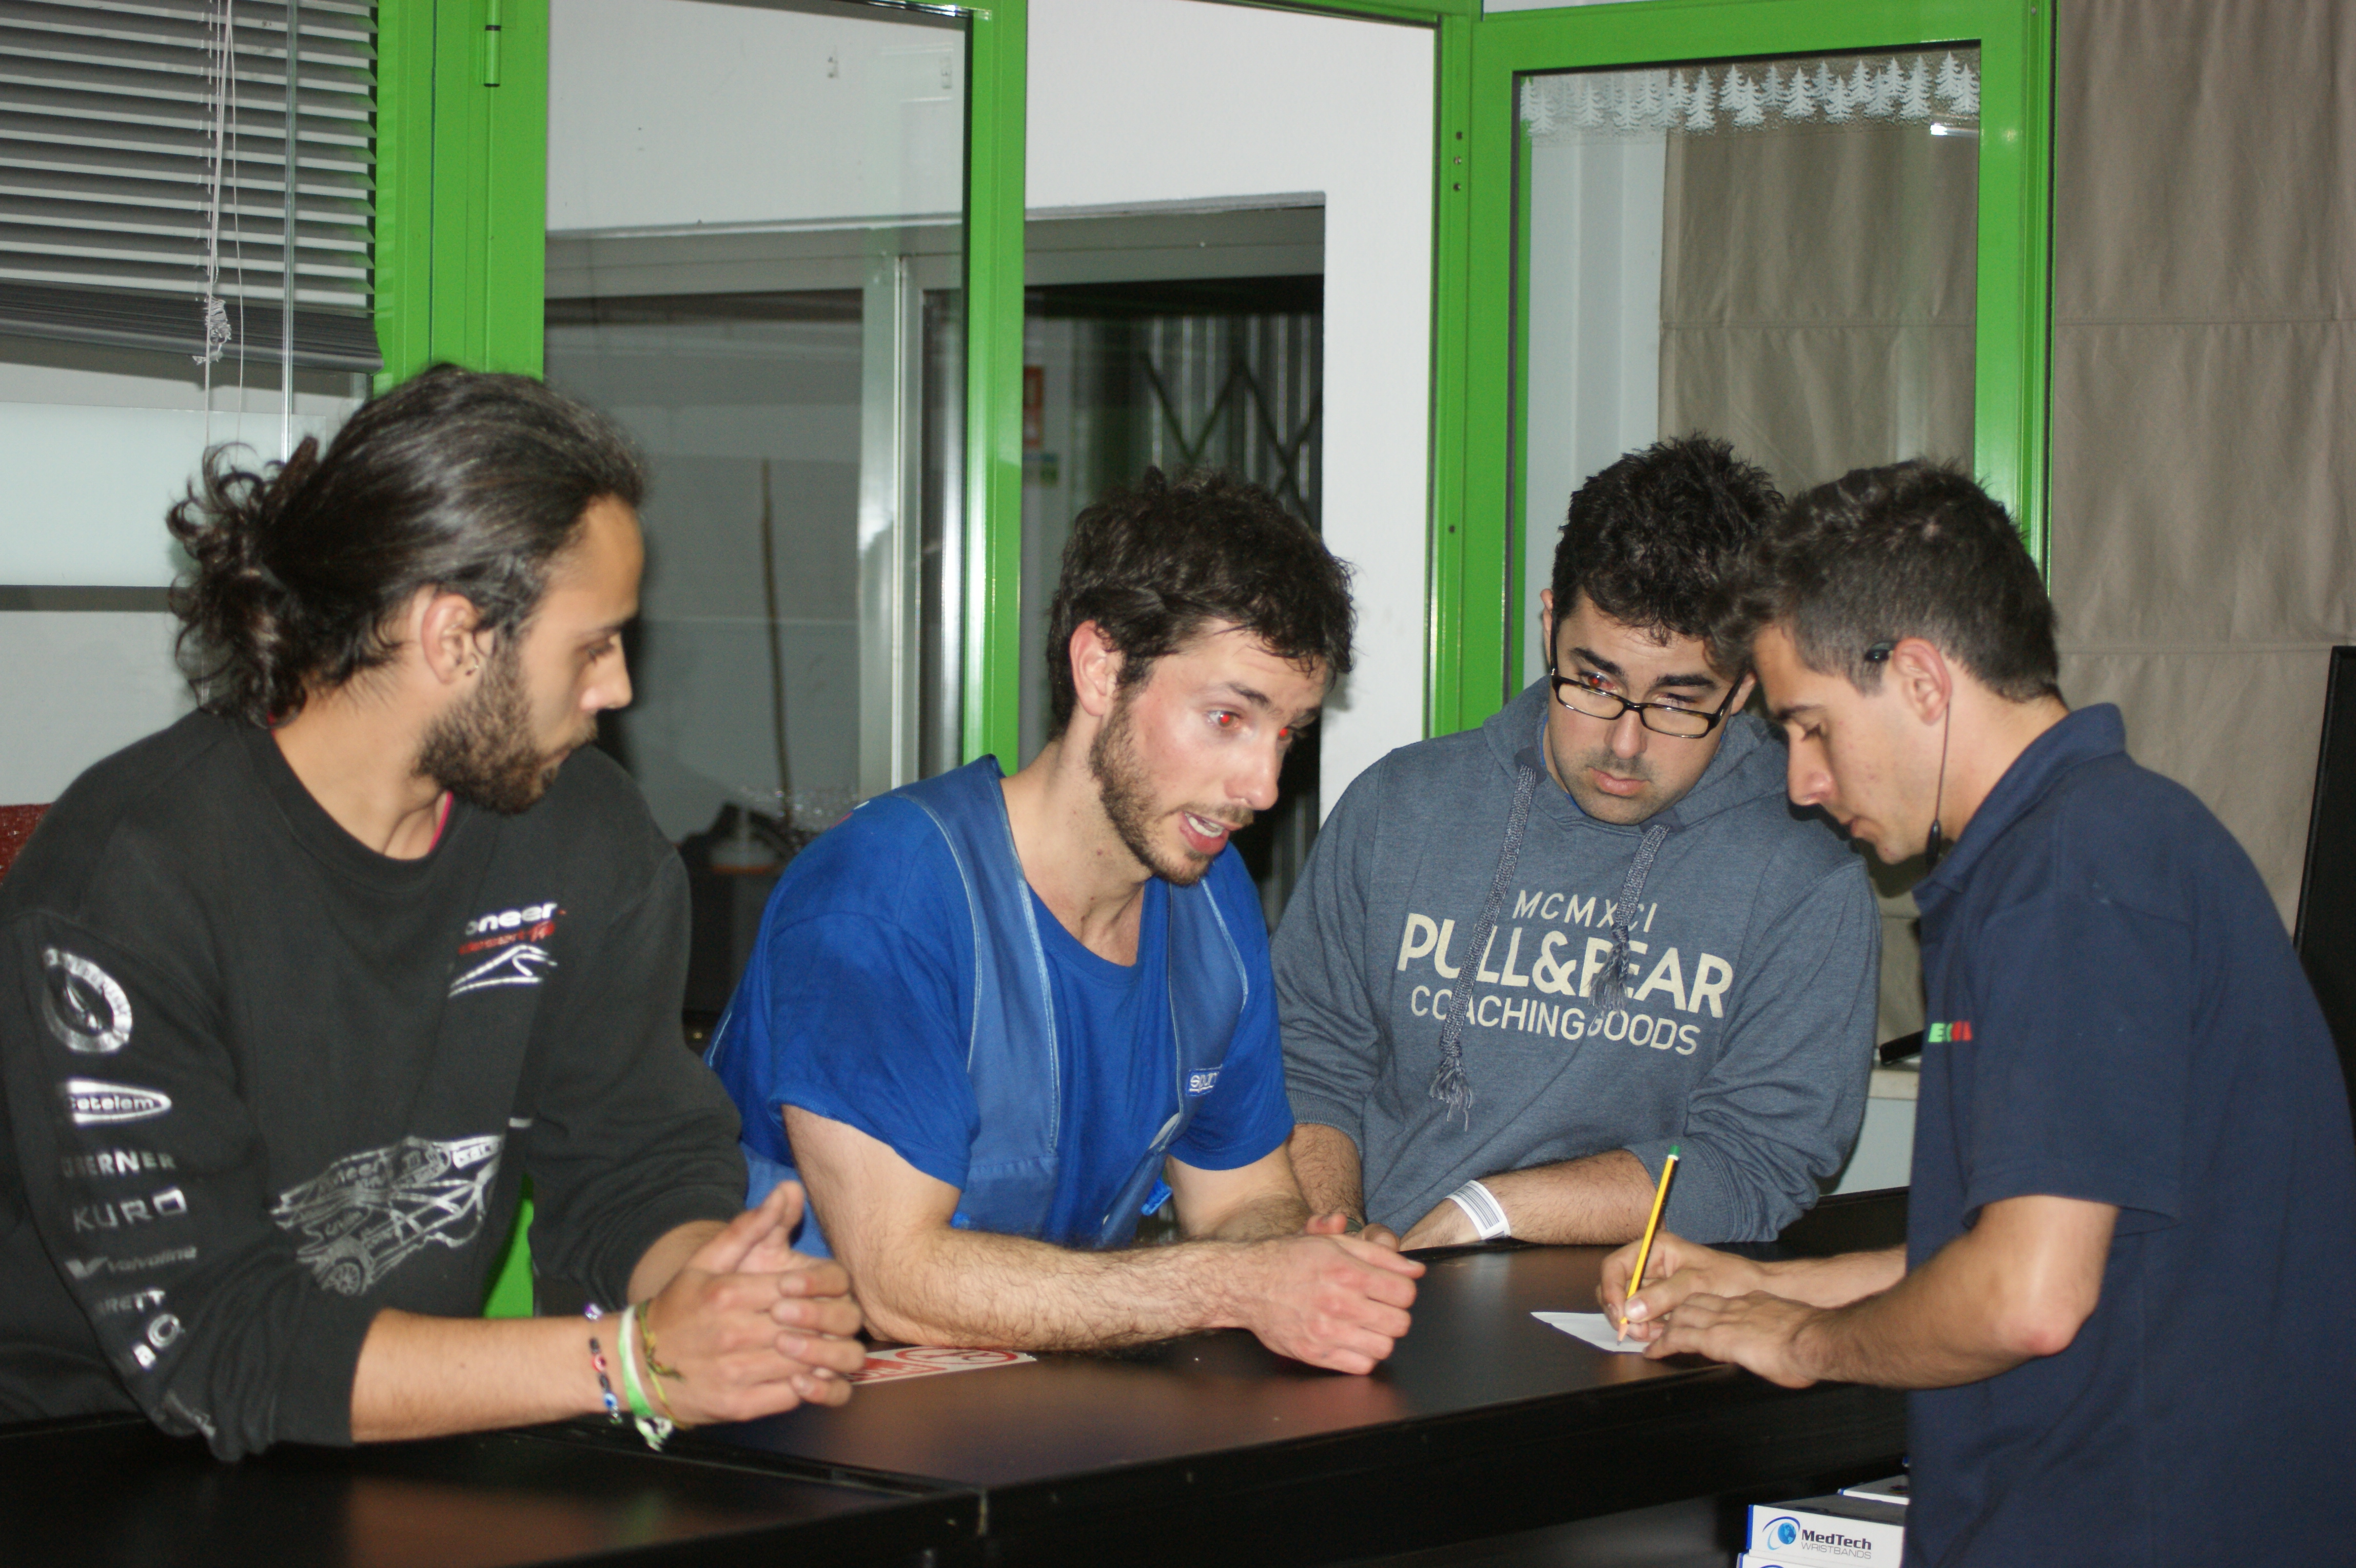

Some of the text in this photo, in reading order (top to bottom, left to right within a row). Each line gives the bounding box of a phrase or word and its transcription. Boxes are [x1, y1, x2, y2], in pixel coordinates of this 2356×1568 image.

[73, 1188, 188, 1232] KURO
[1801, 1529, 1872, 1551] MedTech
[1801, 1541, 1872, 1560] WRISTBANDS
